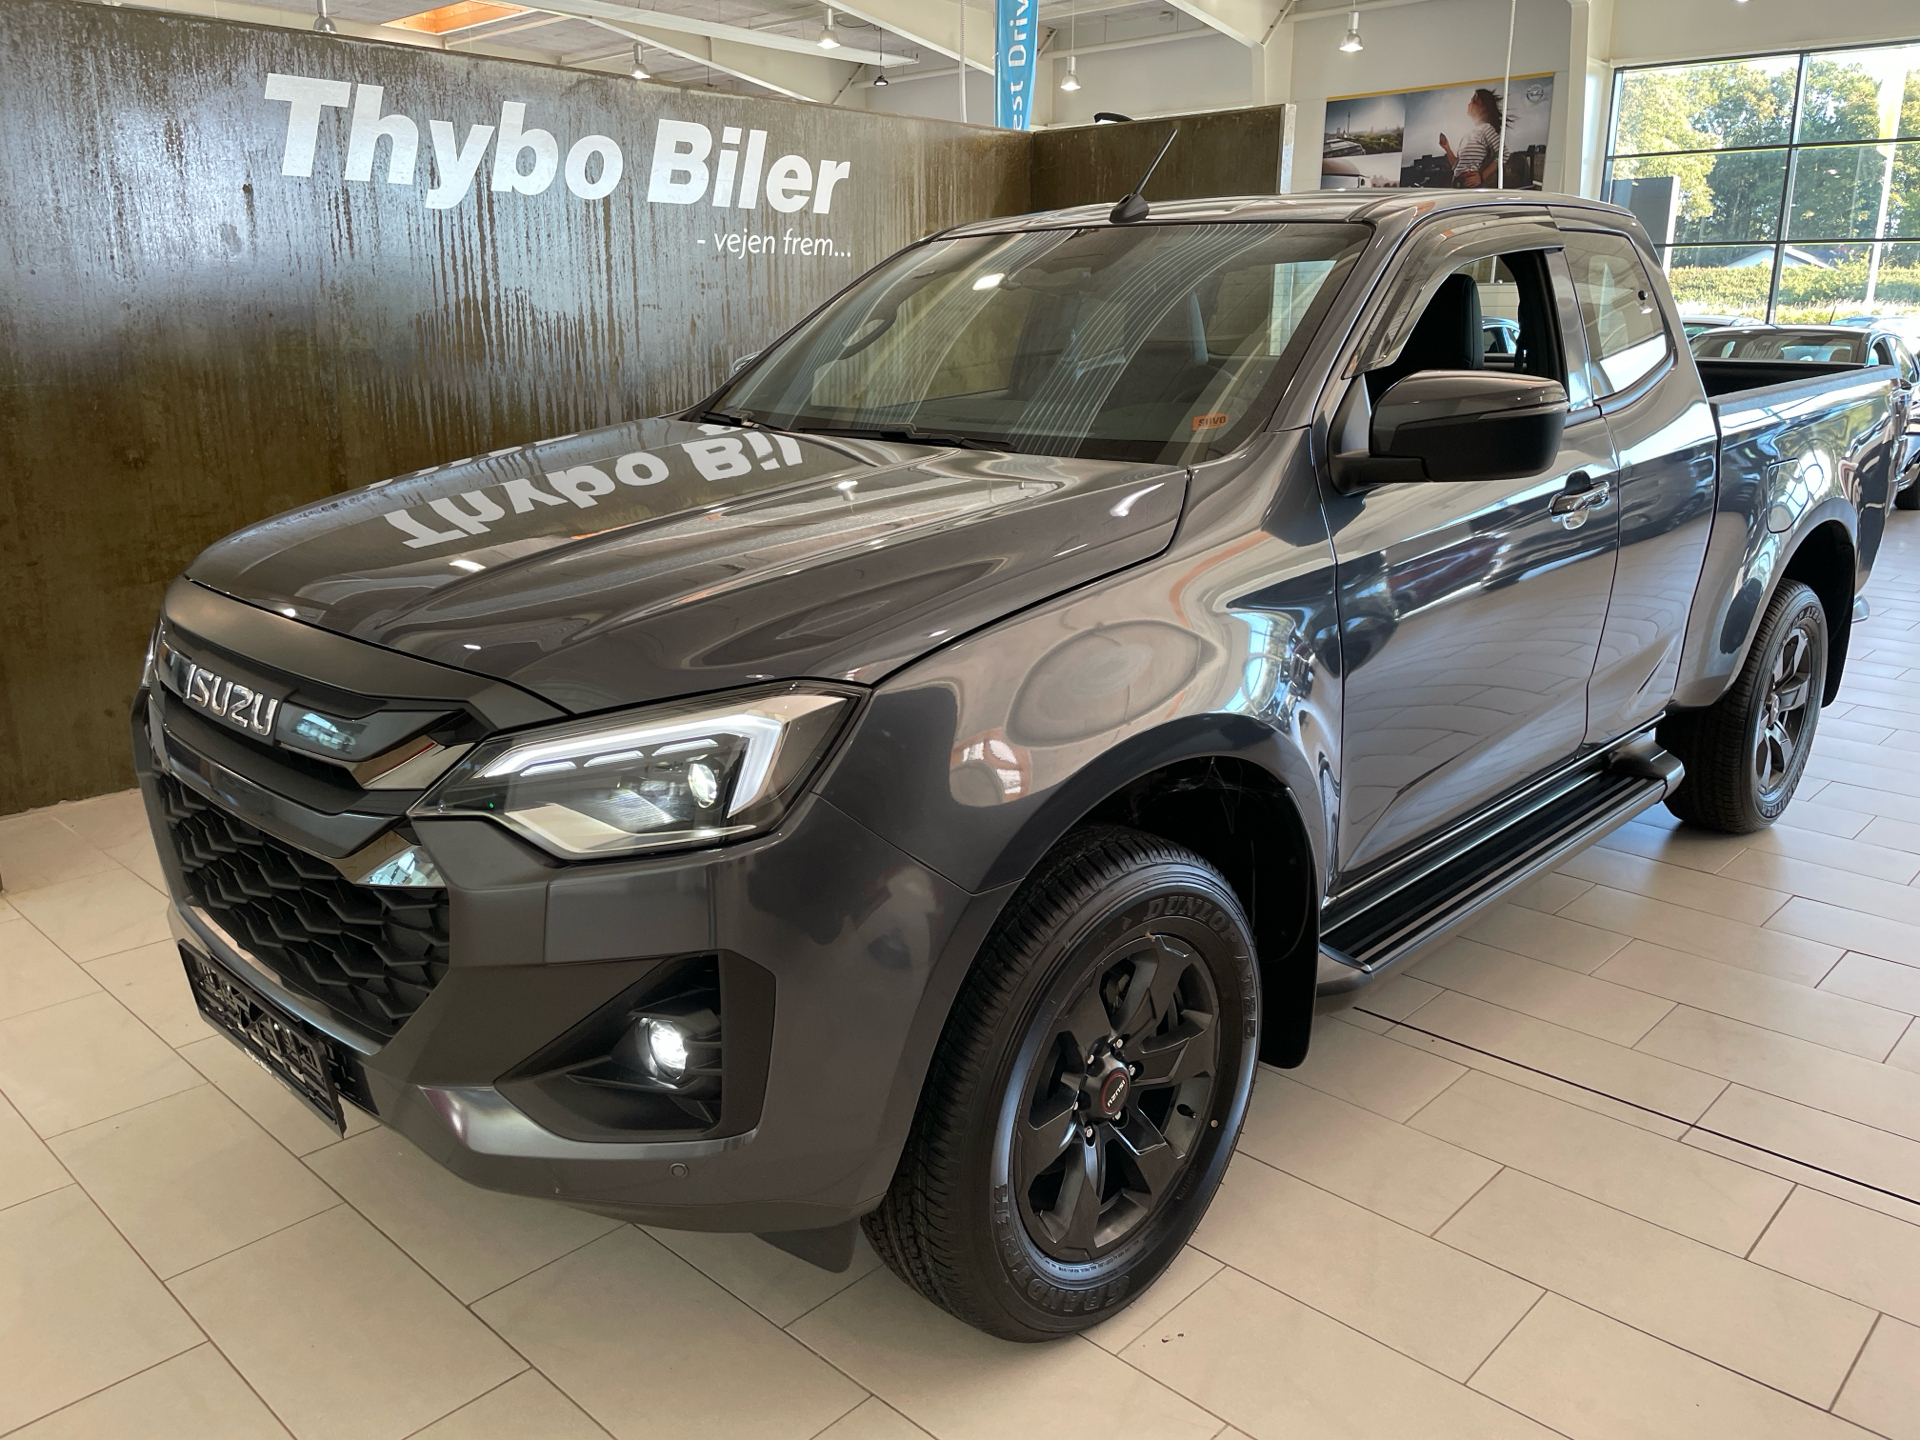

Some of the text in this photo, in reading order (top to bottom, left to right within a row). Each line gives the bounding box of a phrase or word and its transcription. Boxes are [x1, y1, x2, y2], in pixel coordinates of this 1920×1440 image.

[1008, 0, 1030, 130] est Driv
[264, 72, 851, 214] Thybo Biler
[714, 227, 775, 260] vejen
[783, 227, 851, 258] frem...
[185, 663, 279, 736] ISUZU
[1142, 895, 1239, 943] DUNLOP
[1107, 1079, 1126, 1107] ISUZU
[993, 1183, 1131, 1313] GRANDTREK
